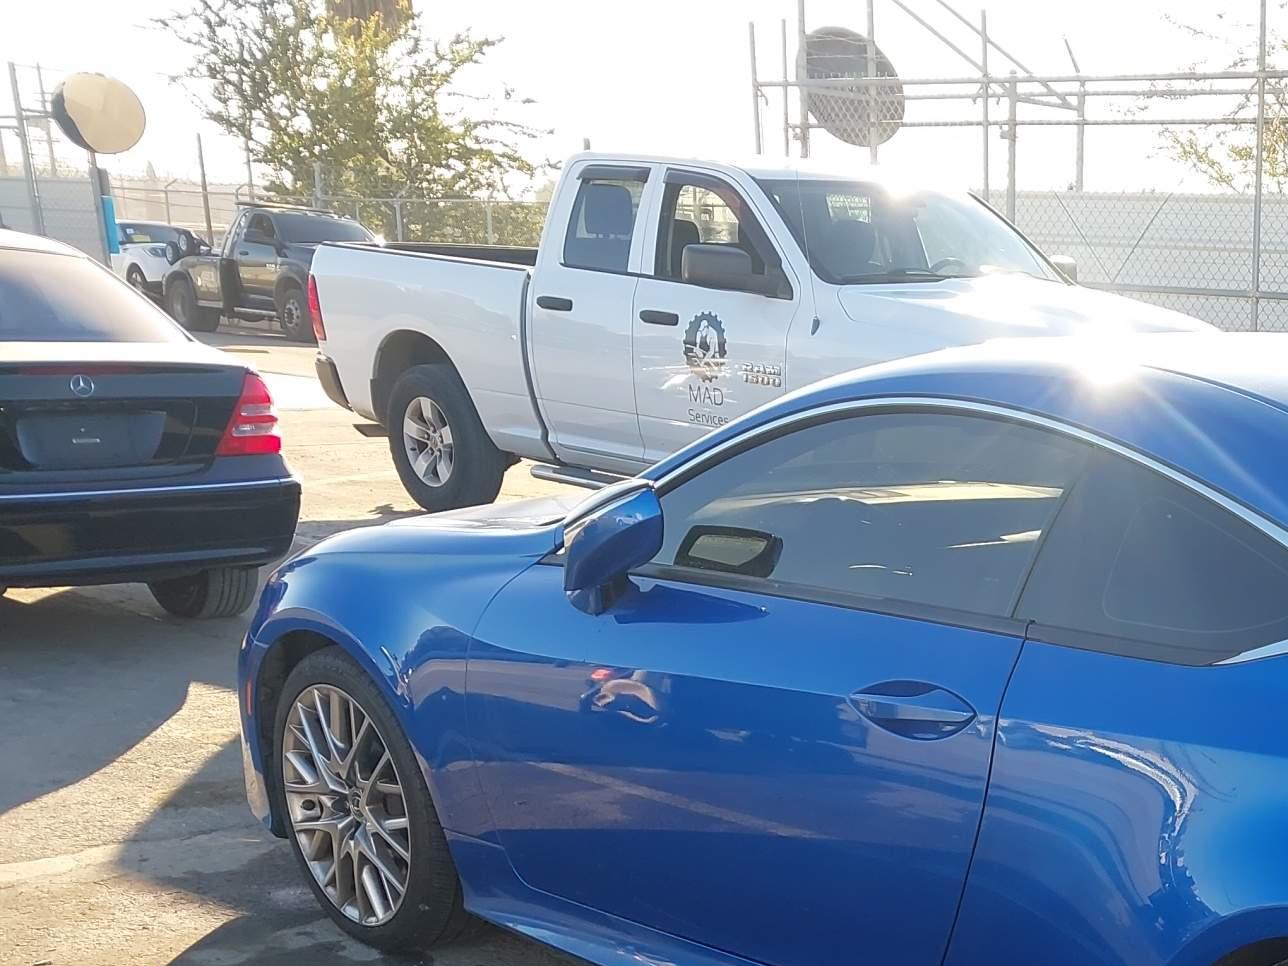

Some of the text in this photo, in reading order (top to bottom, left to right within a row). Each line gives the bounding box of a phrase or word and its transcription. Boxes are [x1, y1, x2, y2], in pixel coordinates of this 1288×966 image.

[743, 361, 782, 376] RAM
[688, 384, 724, 406] MAD
[688, 408, 729, 426] Services
